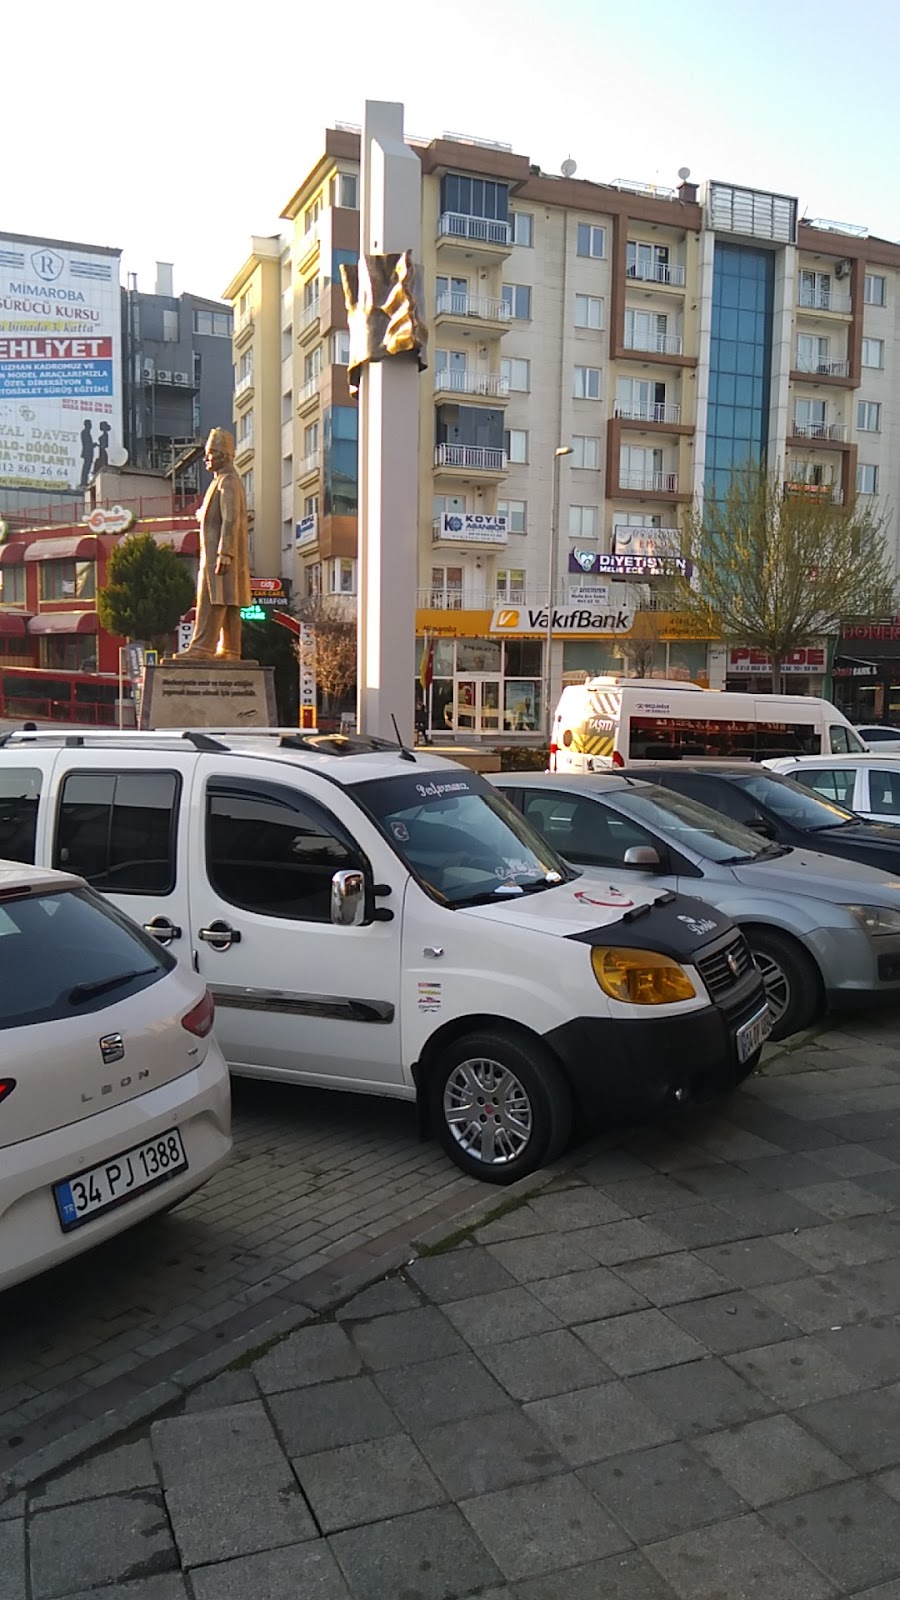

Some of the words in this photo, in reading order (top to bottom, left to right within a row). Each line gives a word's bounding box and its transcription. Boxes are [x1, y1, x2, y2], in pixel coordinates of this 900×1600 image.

[40, 256, 55, 274] R
[9, 282, 85, 302] MİMAROBA
[55, 305, 100, 321] KURSU
[40, 466, 53, 476] 26
[56, 468, 69, 477] 64
[731, 648, 824, 665] PEDE
[81, 1069, 149, 1102] LEON
[72, 1175, 102, 1211] 34
[105, 1157, 134, 1196] PJ
[139, 1136, 180, 1177] 1388
[64, 1203, 75, 1214] TR
